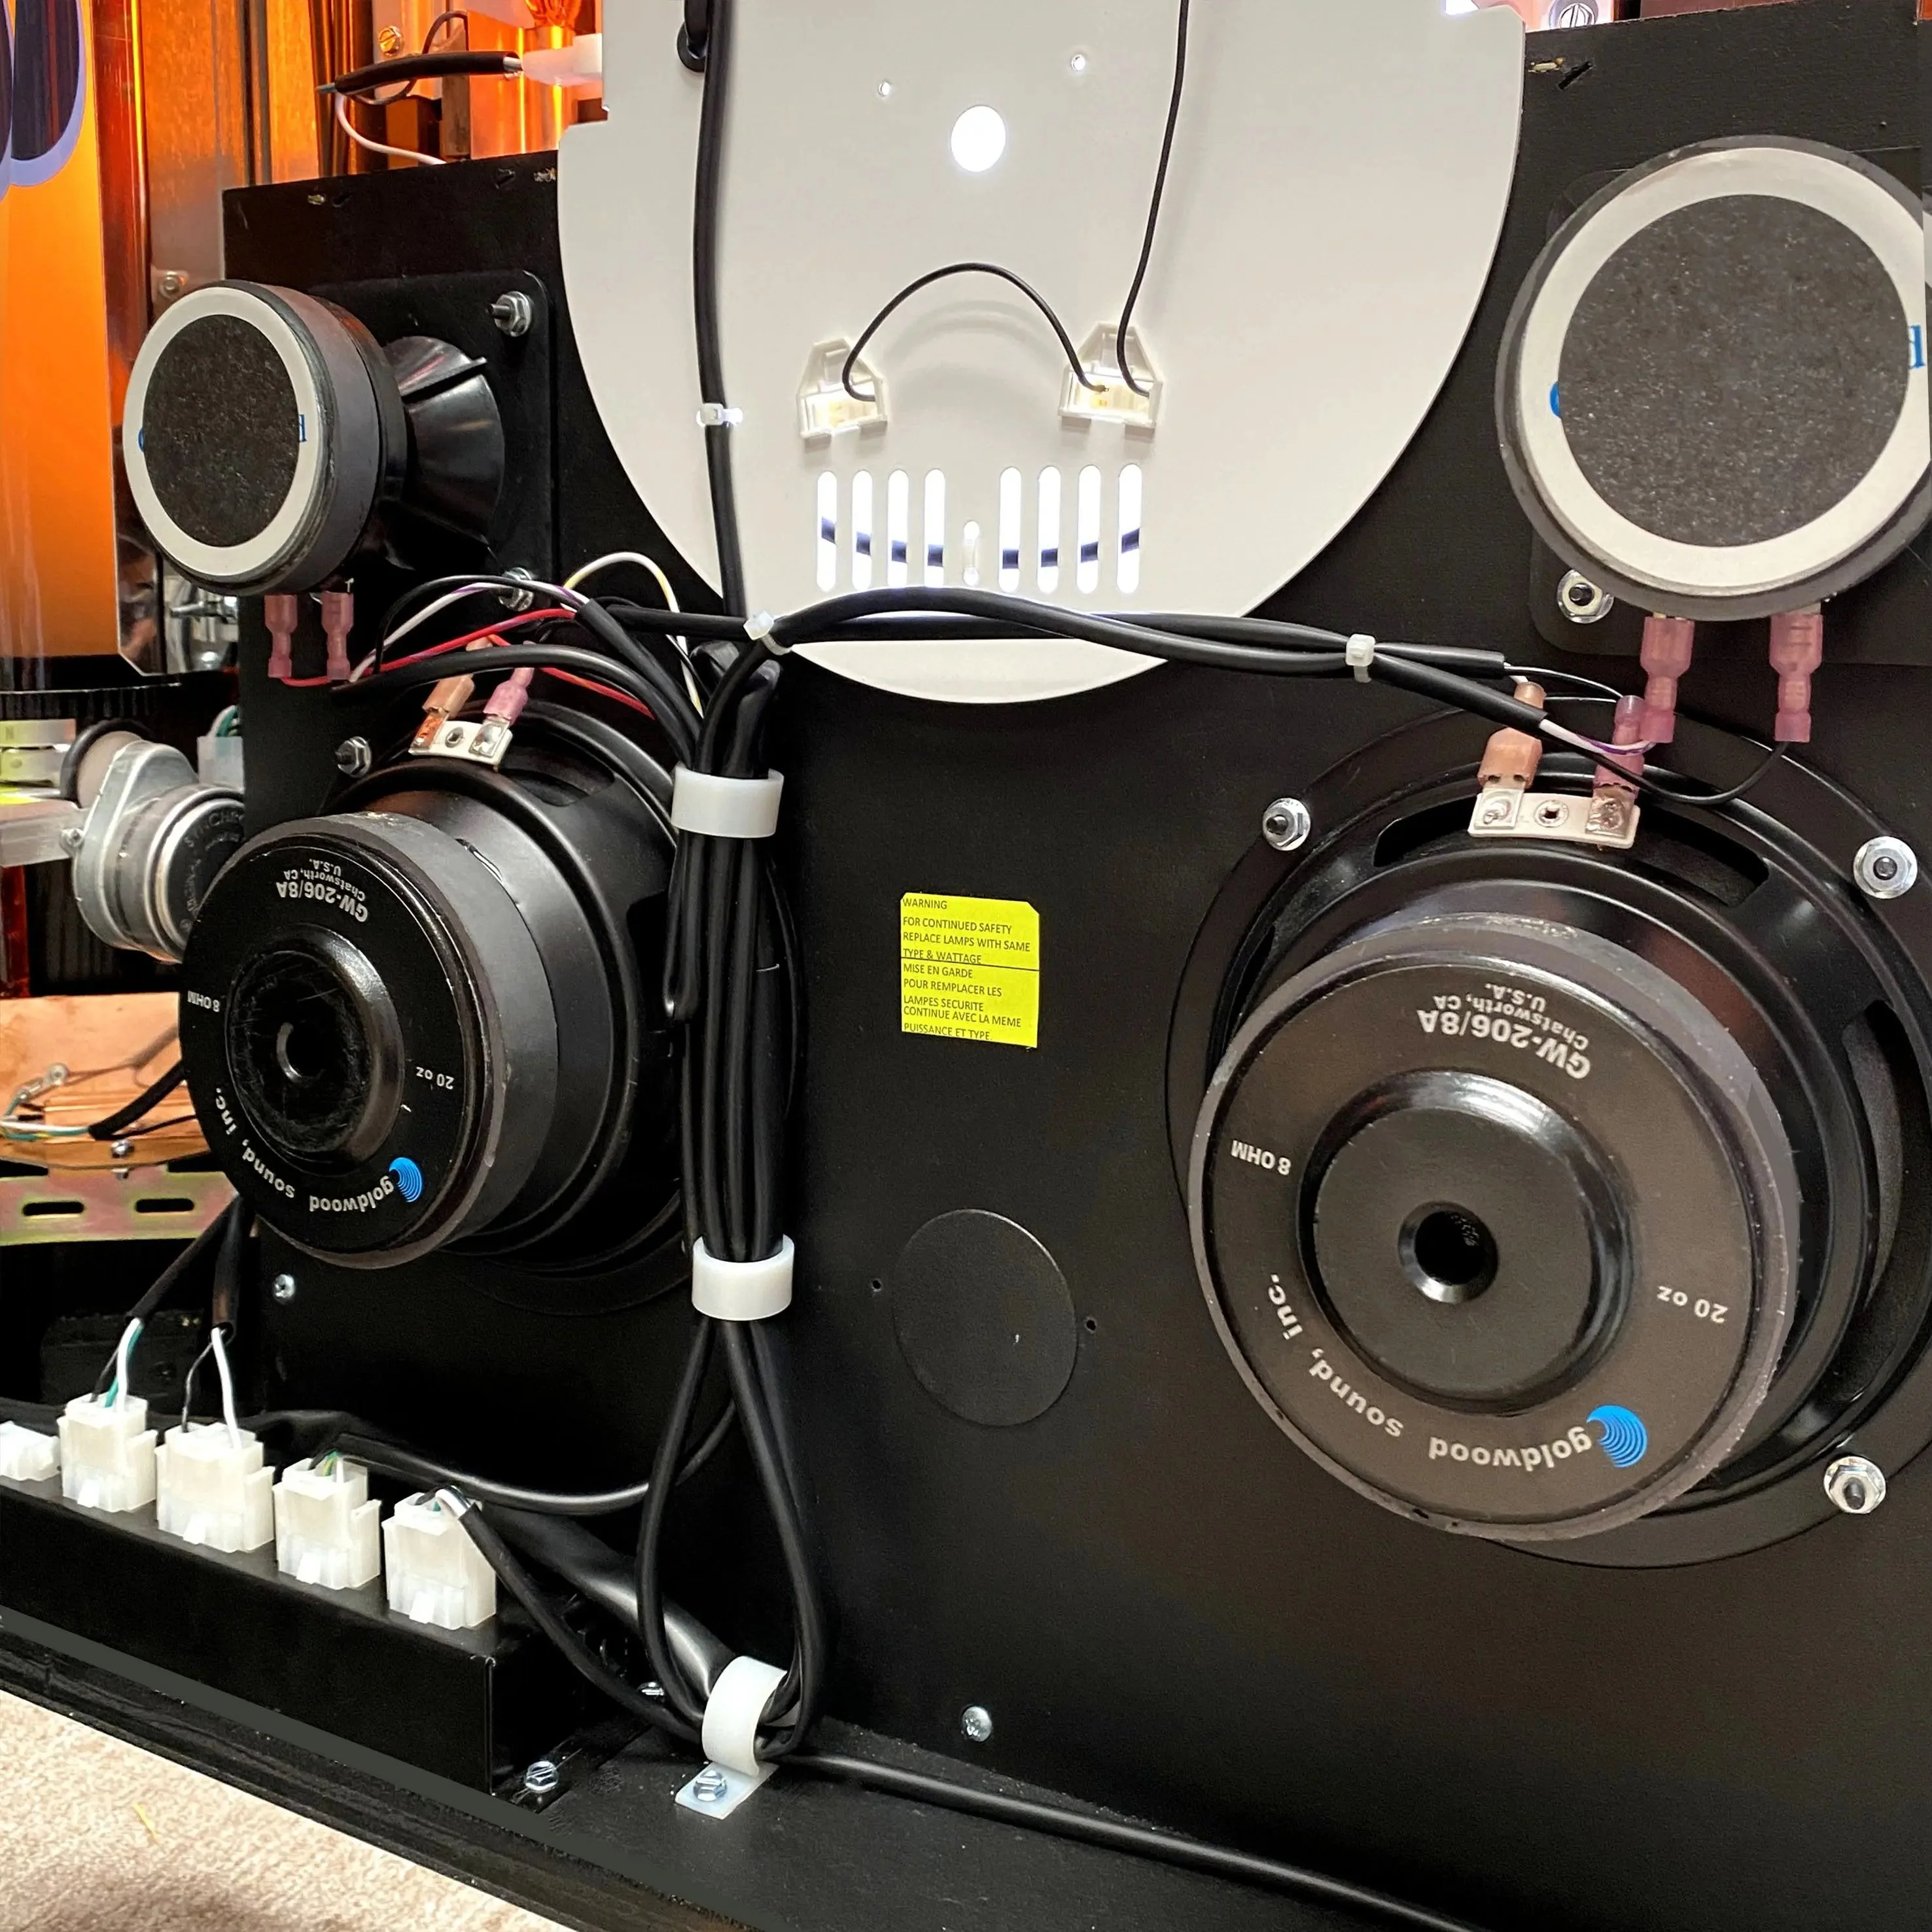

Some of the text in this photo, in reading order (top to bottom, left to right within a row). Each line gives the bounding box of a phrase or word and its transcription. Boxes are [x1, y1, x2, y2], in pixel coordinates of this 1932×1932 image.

[309, 858, 342, 877] U.S.A.
[283, 868, 366, 902] Chatsworth, CA
[275, 879, 368, 922] GW-206/8A
[903, 898, 947, 909] WARNING
[903, 917, 1012, 934] FOR CONTINUED SAFETY
[903, 932, 1030, 952] REPLACE LAMPS WITH SAME
[903, 949, 981, 964] TYPE & WATTAGE
[904, 964, 973, 978] MISE EN GARDE
[904, 979, 1002, 997] POUR REMPLACER LES
[1485, 983, 1546, 1013] U.S.A.
[187, 990, 220, 1012] 8 OHM
[904, 995, 983, 1011] LAMPES SECURITE
[904, 1006, 1021, 1027] CONTINUE AVEC LA MEME
[1433, 993, 1589, 1050] Chatsworth, CA
[904, 1023, 952, 1036] PUISSANCE
[955, 1028, 966, 1037] ET
[1416, 1010, 1590, 1079] GW-206/8A
[416, 1066, 454, 1089] 20 oz
[215, 1087, 394, 1212] goldwood sound, inc.
[1231, 1140, 1291, 1175] 8 OHM
[1657, 1286, 1728, 1323] 20 oz
[1268, 1274, 1592, 1471] goldwood sound, inc.
